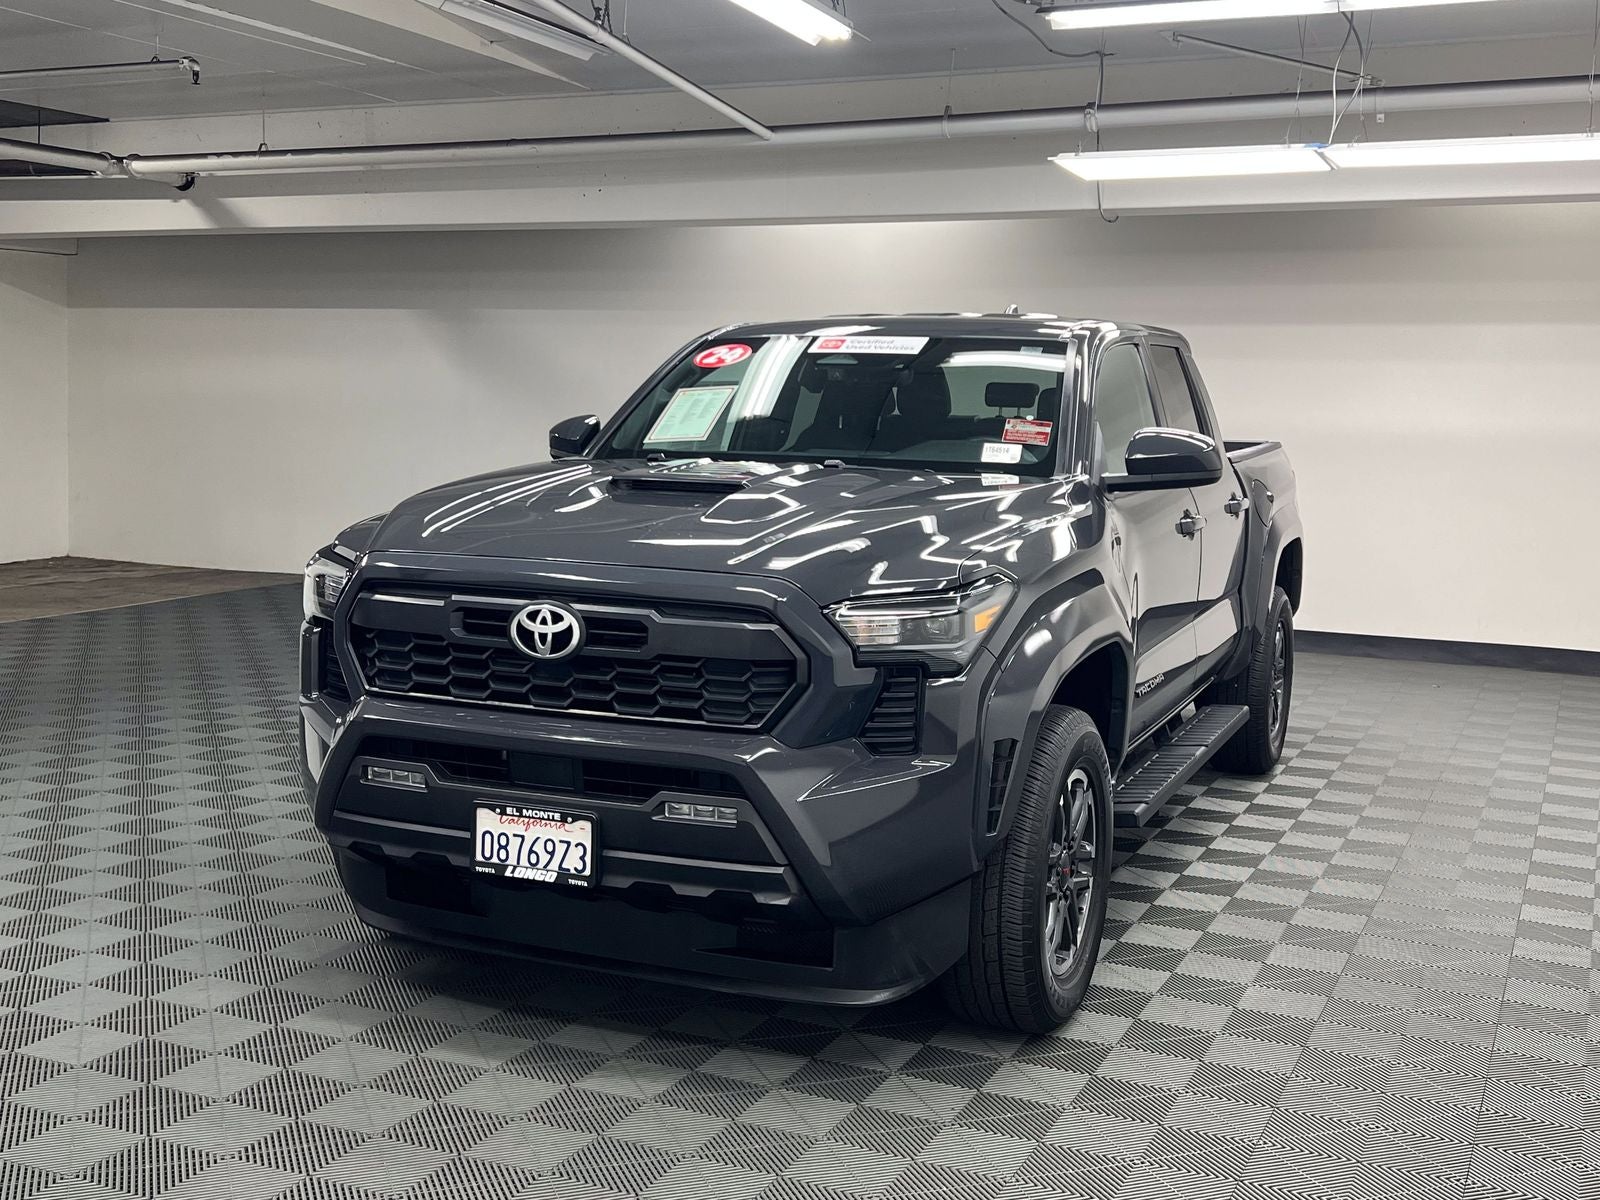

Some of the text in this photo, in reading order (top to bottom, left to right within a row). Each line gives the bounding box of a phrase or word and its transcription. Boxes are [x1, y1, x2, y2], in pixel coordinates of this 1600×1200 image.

[1136, 673, 1165, 697] TACOMA
[499, 814, 573, 832] California
[506, 807, 561, 821] EL MONTE
[481, 829, 588, 875] 08769Z3
[475, 865, 588, 887] TOYOTA LONGO TOYOTA
